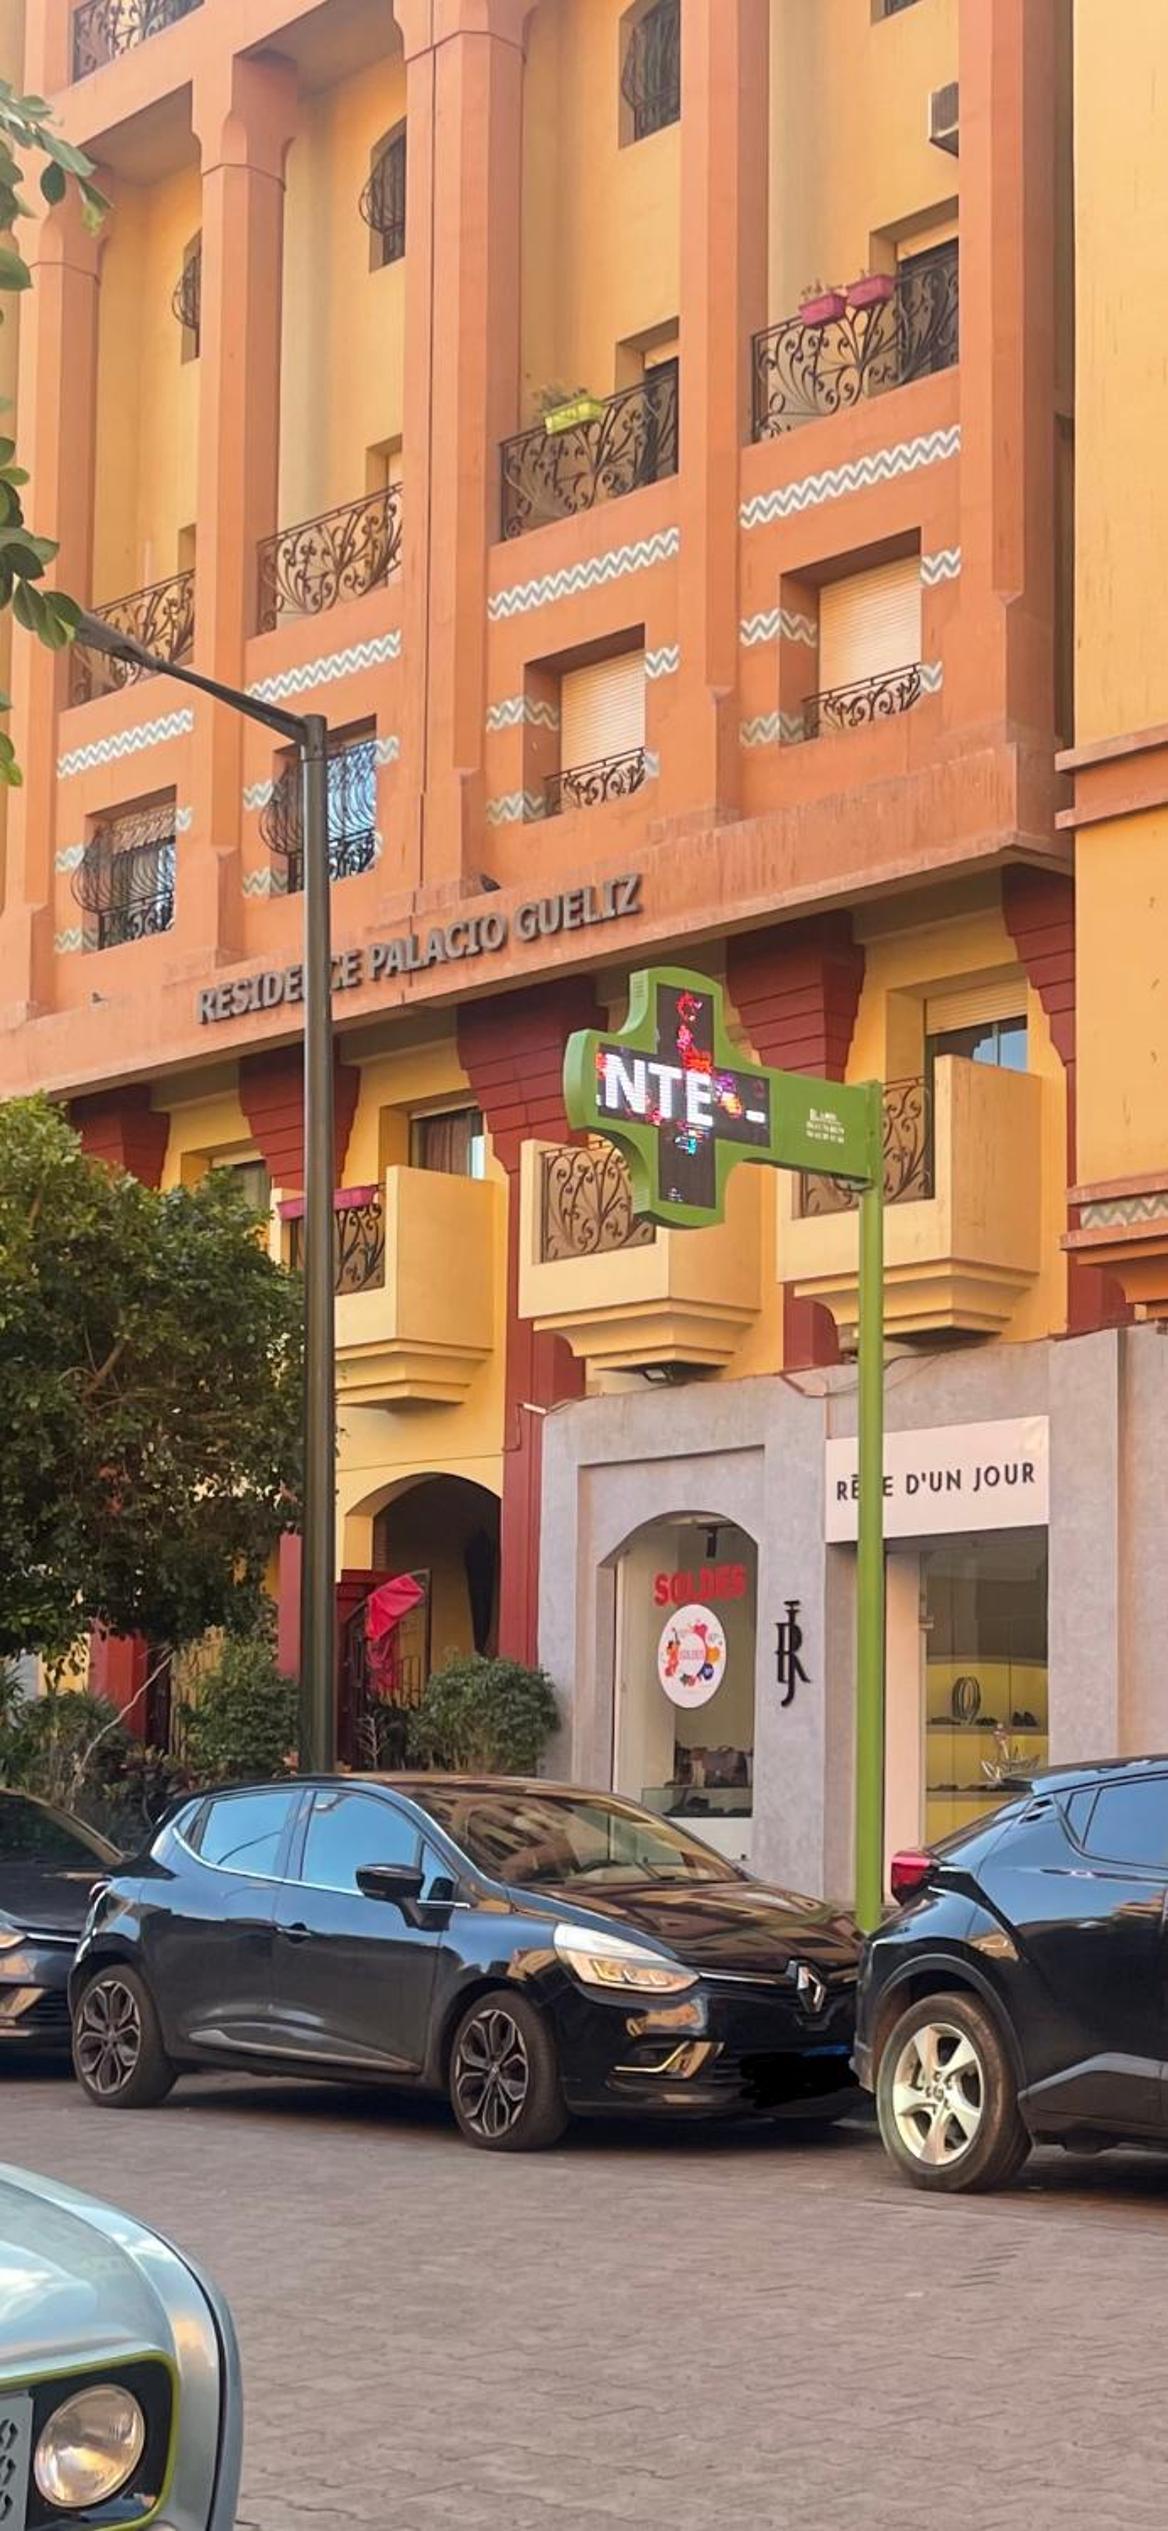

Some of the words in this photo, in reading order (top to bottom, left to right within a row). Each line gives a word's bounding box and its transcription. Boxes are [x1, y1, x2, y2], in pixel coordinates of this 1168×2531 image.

[198, 949, 363, 1024] RESIDECE
[369, 910, 508, 981] PALACIO
[514, 873, 644, 943] GUELIZ
[596, 1053, 714, 1127] NTE
[836, 1474, 894, 1501] RÊE
[906, 1469, 963, 1495] D'UN
[973, 1462, 1036, 1492] JOUR
[654, 1564, 747, 1606] SOLDES
